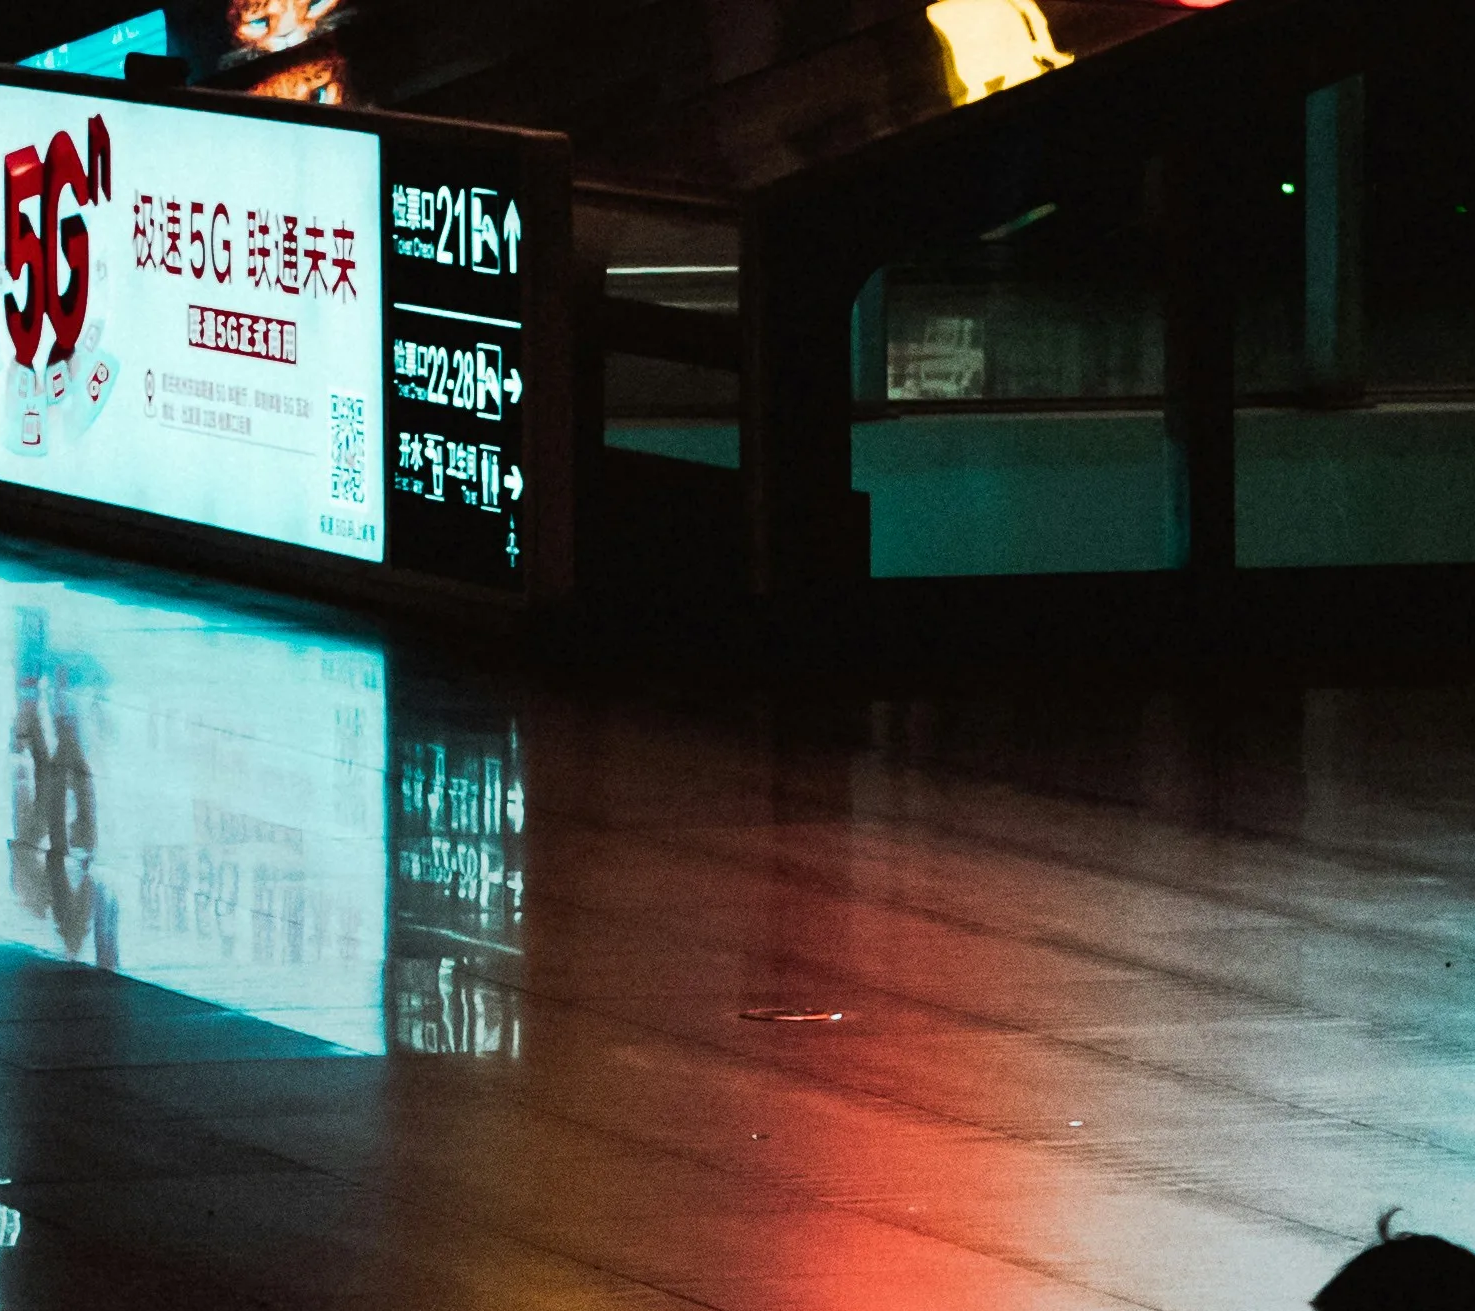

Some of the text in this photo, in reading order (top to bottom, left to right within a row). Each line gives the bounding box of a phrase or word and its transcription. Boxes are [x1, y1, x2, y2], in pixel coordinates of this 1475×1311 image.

[132, 189, 357, 304] 极速5G 联通未来
[436, 185, 466, 267] 21
[426, 345, 474, 410] 22-28
